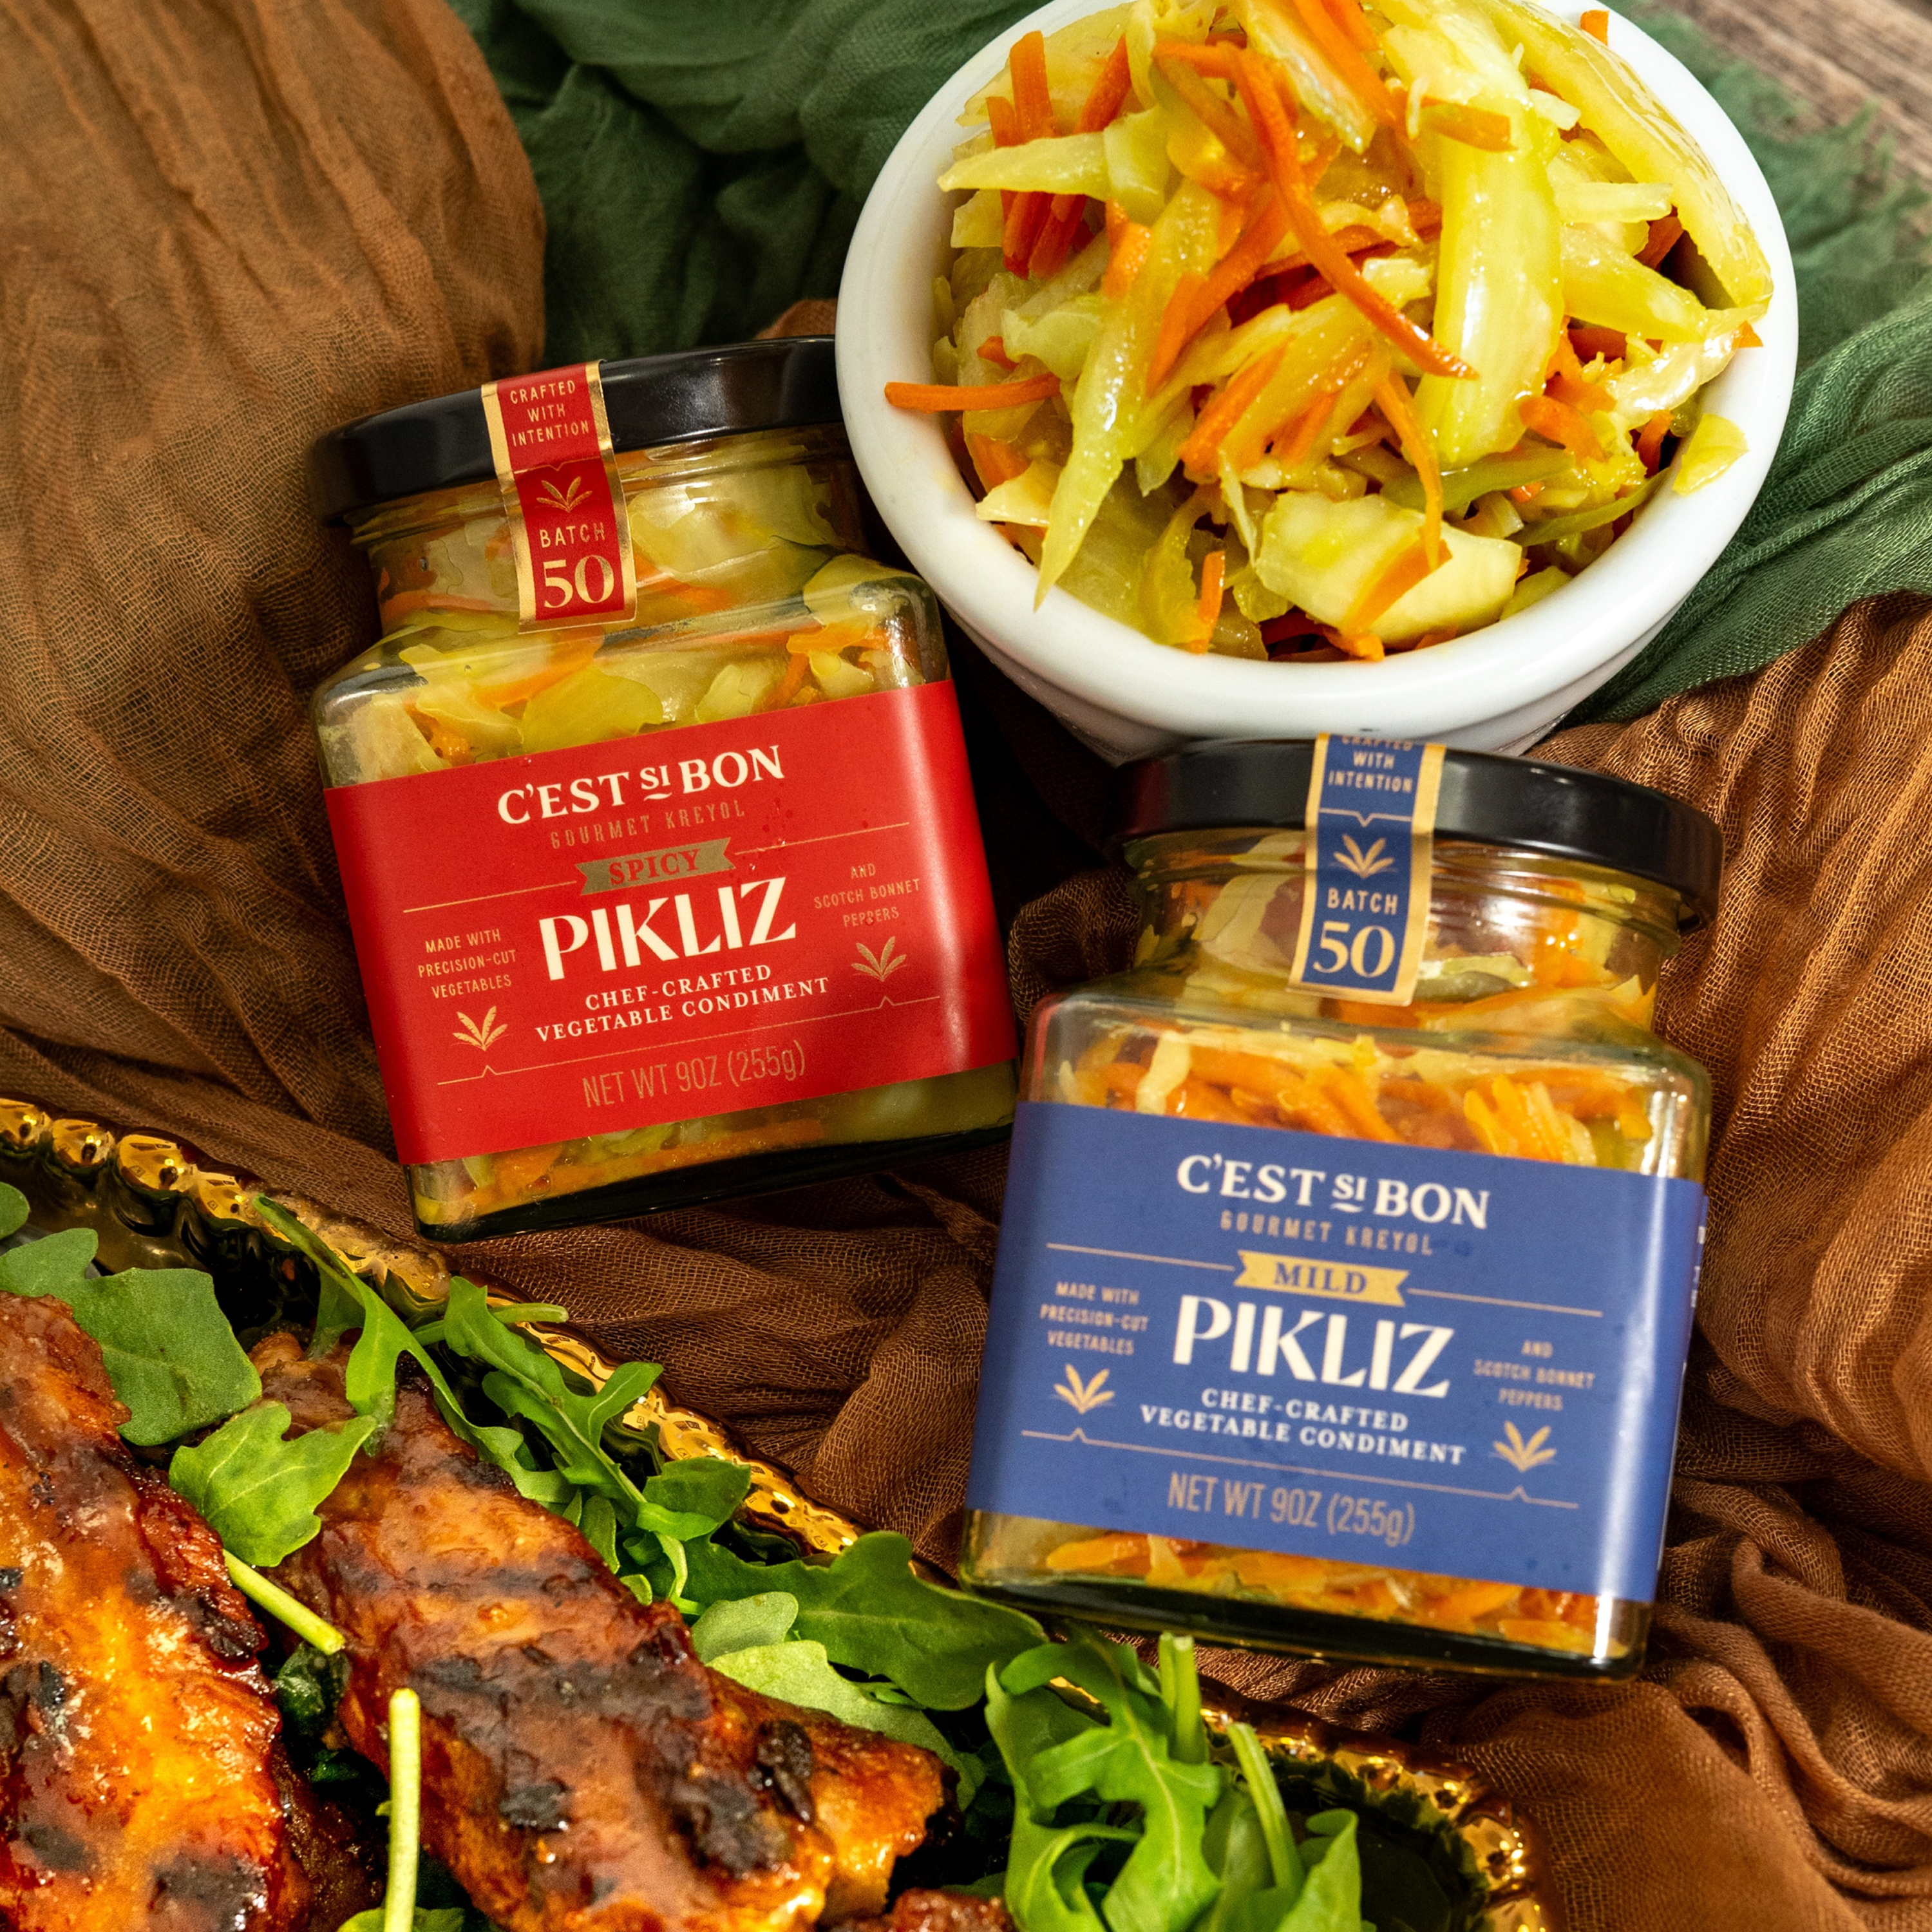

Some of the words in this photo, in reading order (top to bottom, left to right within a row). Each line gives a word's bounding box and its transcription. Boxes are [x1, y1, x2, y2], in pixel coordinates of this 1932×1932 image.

[510, 380, 576, 404] CRAFTED
[527, 403, 565, 422] WITH
[512, 420, 589, 447] INTENTION
[539, 522, 605, 548] BATCH
[543, 554, 614, 608] 50
[1354, 751, 1395, 769] WITH
[497, 772, 630, 824] C'EST
[640, 765, 672, 792] SI
[678, 745, 785, 794] BON
[1328, 770, 1412, 793] INTENTION
[551, 815, 650, 849] GOURMET
[665, 799, 745, 830] KREYOL
[609, 848, 701, 886] SPICY
[851, 863, 876, 879] AND
[813, 889, 864, 909] SCOTCH
[870, 878, 920, 900] BONNET
[1327, 887, 1398, 915] BATCH
[539, 876, 796, 981] PIKLIZ
[843, 906, 899, 927] PEPPERS
[425, 935, 462, 953] MADE
[466, 928, 501, 946] WITH
[1312, 920, 1396, 978] 50
[418, 949, 516, 978] PRECISION-CUT
[431, 974, 512, 999] VEGETABLES
[585, 964, 772, 1010] CHEF-CRAFTED
[535, 1004, 674, 1042] VEGETABLE
[681, 977, 829, 1018] CONDIMENT
[582, 1071, 625, 1108] NET
[630, 1063, 668, 1099] WT
[728, 1039, 806, 1087] (255g)
[1177, 1153, 1326, 1206] C'EST
[1332, 1173, 1367, 1202] SI
[1373, 1178, 1491, 1230] BON
[1220, 1209, 1332, 1242] GOURMET
[1345, 1225, 1432, 1256] KREYOL
[1056, 1281, 1095, 1301] MADE
[1273, 1261, 1368, 1295] MILD
[1047, 1330, 1134, 1356] VEGETABLES
[1173, 1294, 1455, 1398] PIKLIZ
[1201, 1388, 1408, 1432] CHEF-CRAFTED
[1140, 1404, 1291, 1442] VEGETABLE
[1300, 1426, 1466, 1465] CONDIMENT
[1167, 1472, 1218, 1511] NET
[1224, 1480, 1265, 1519] WT
[1327, 1492, 1416, 1546] (255g)
